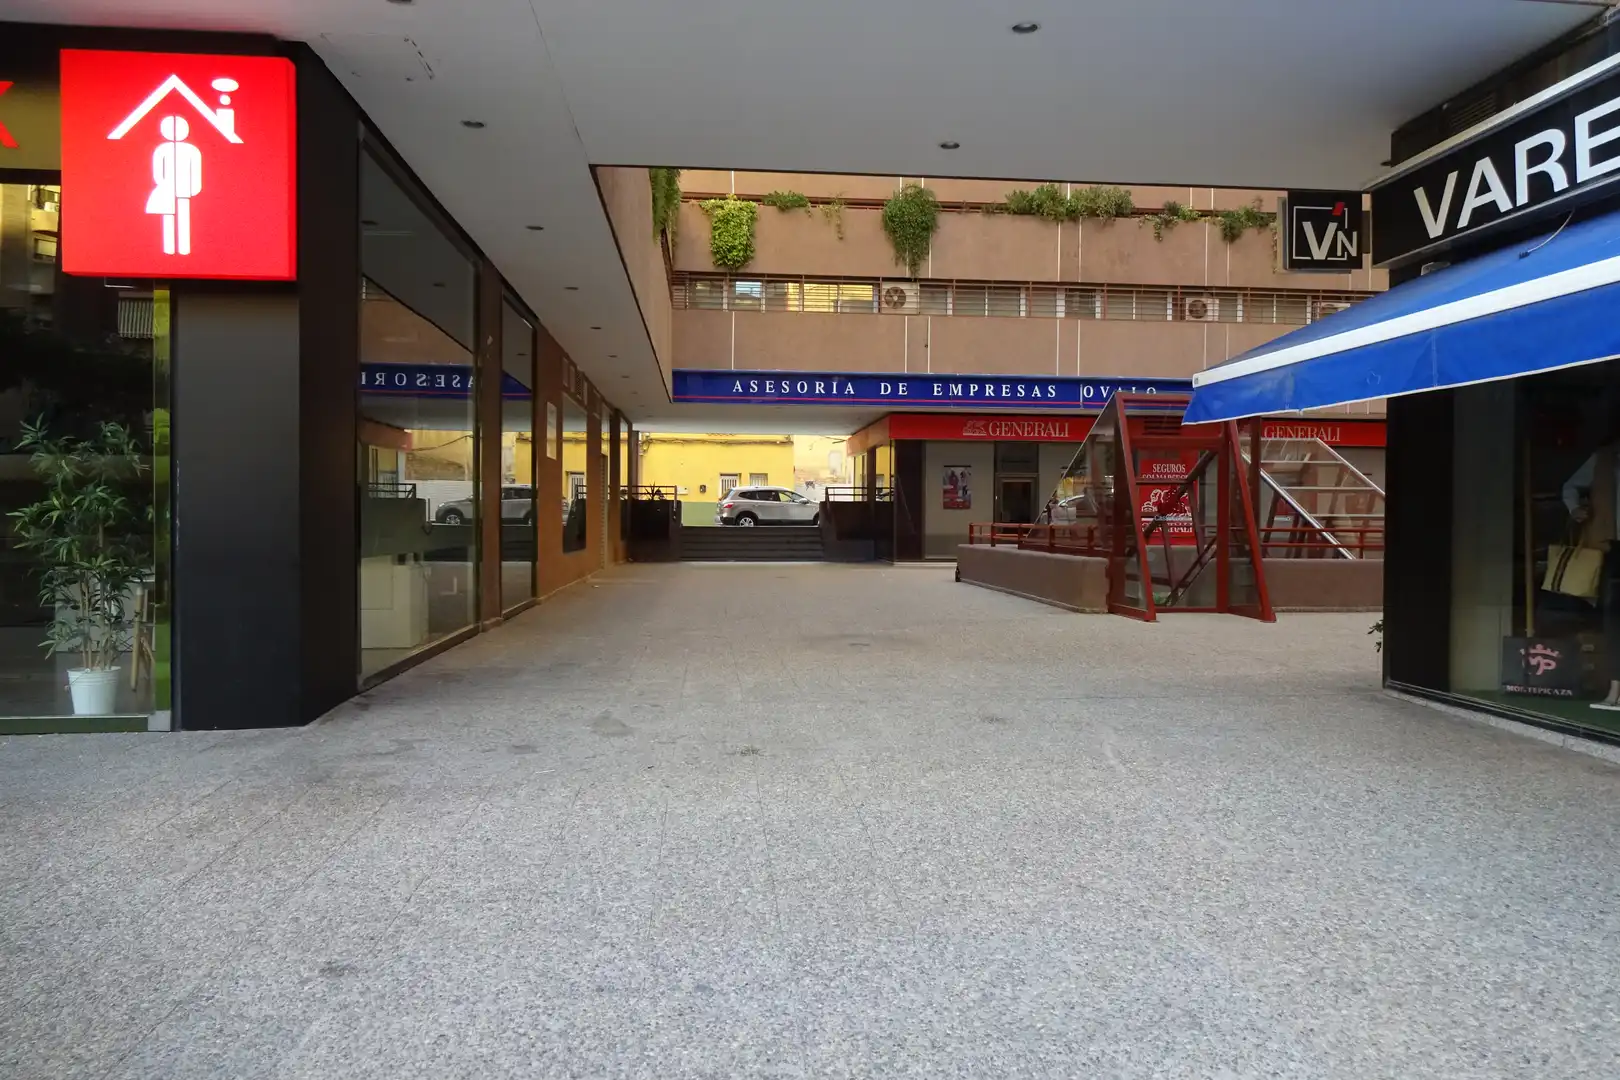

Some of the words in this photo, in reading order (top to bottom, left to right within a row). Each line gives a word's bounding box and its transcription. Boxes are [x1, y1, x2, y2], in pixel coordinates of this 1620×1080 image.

[1413, 97, 1620, 239] VARE
[732, 380, 855, 394] ASESORIA
[880, 382, 908, 395] DE
[933, 383, 1056, 397] EMPRESAS
[988, 421, 1069, 438] GENERALI
[1264, 424, 1341, 441] GENERALI
[1152, 463, 1186, 473] SEGUROS
